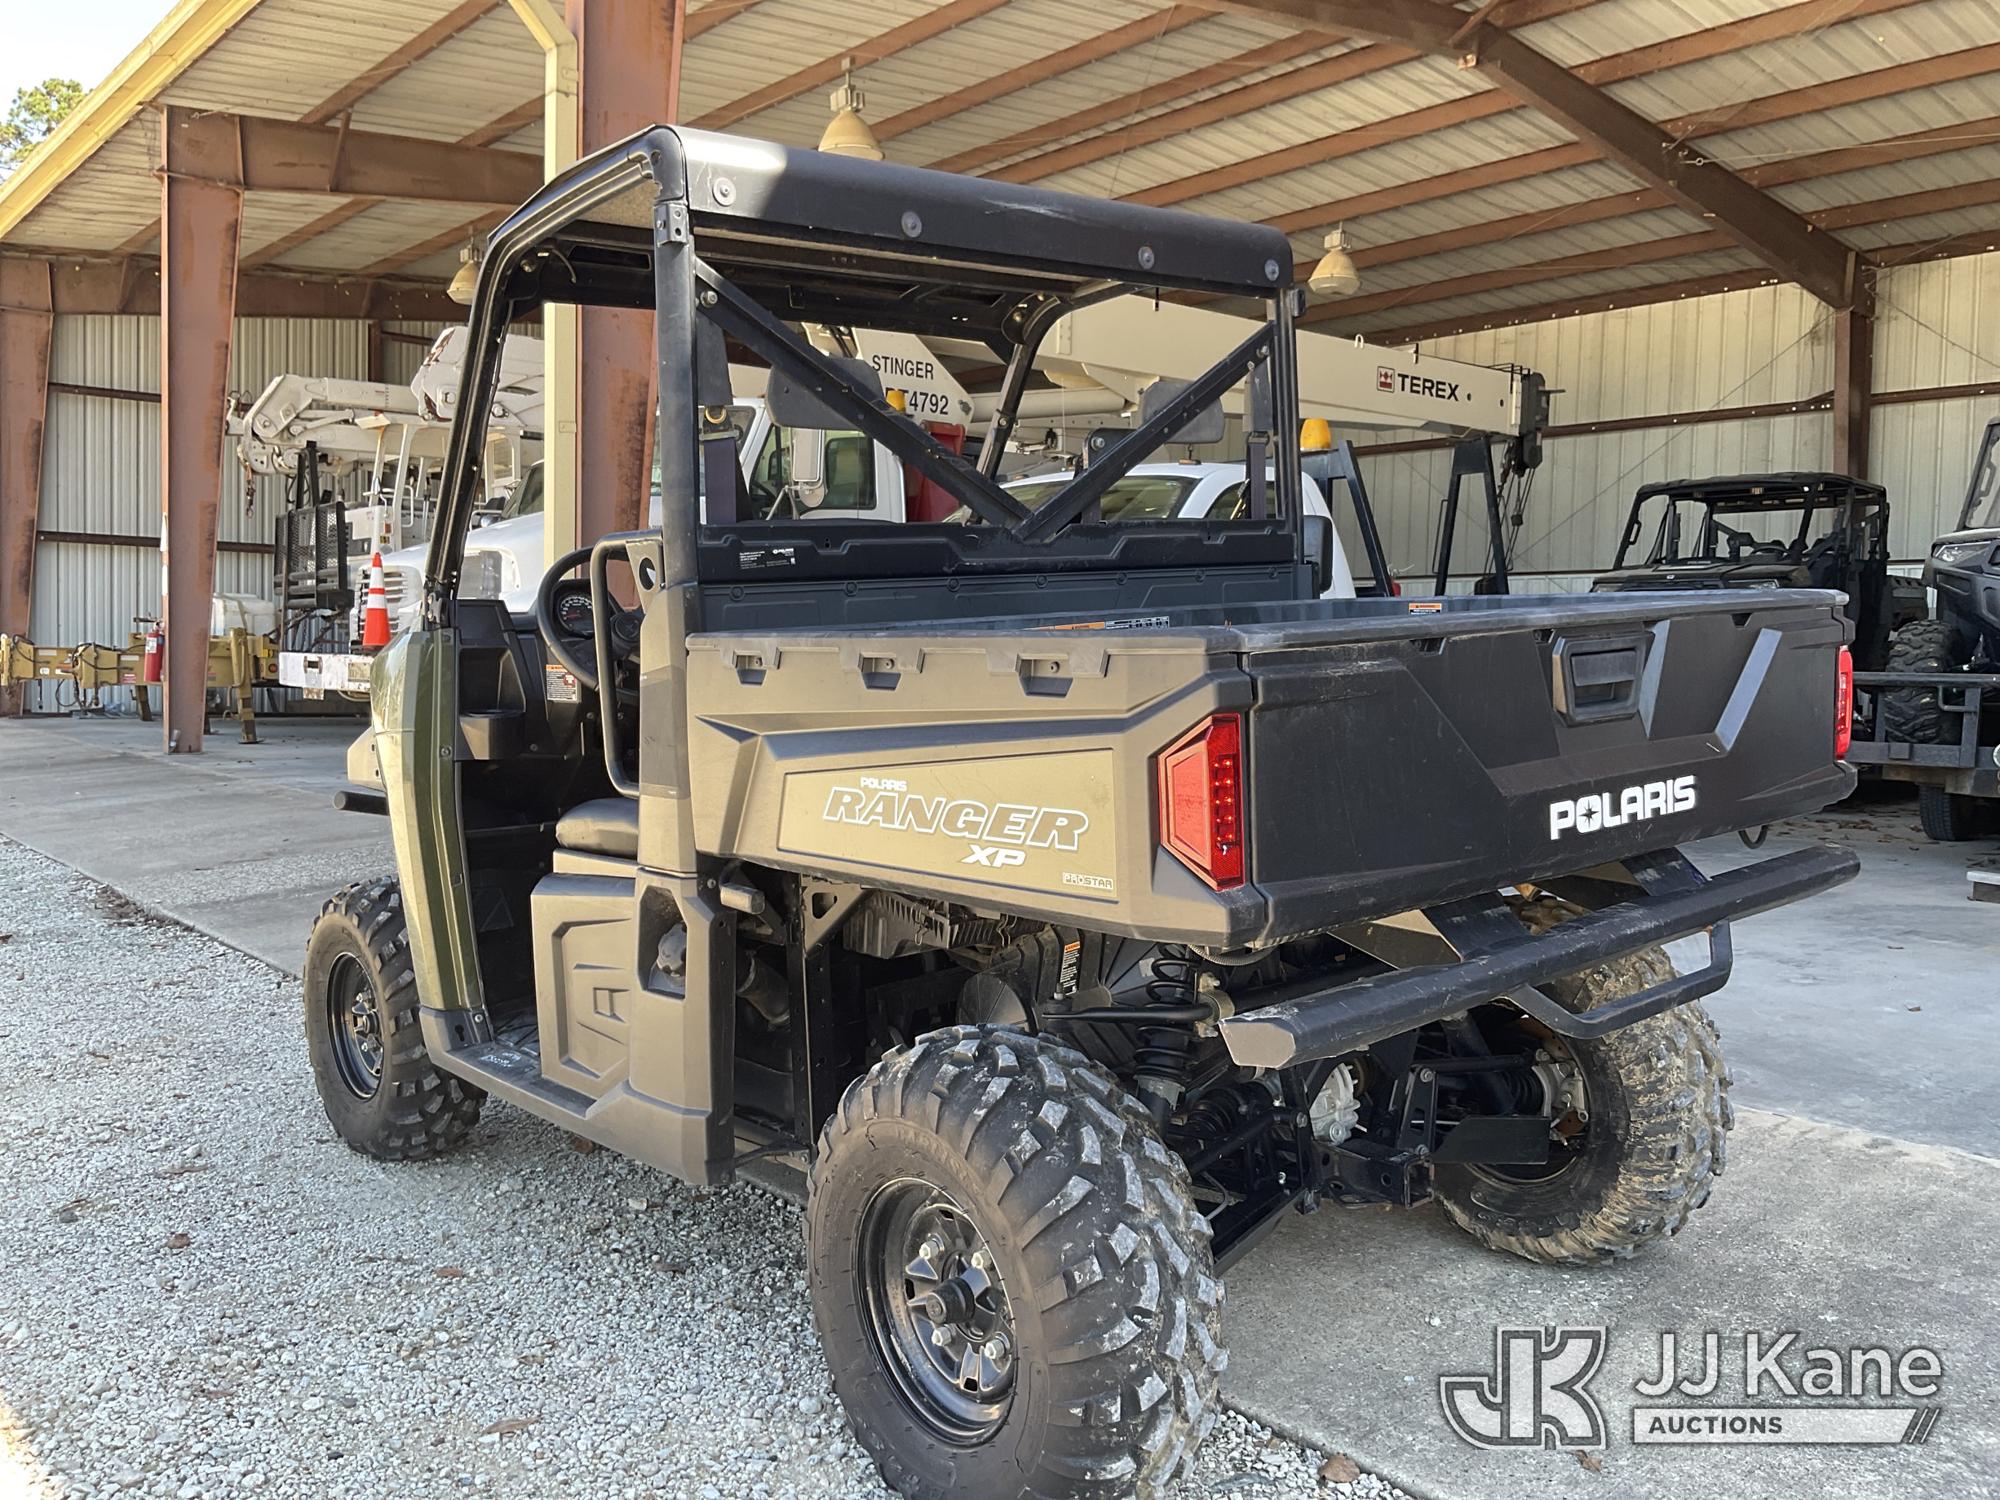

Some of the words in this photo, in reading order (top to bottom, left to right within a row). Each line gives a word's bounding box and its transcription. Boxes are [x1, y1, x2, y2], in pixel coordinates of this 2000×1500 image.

[872, 354, 934, 380] STINGER
[885, 386, 949, 415] 4792
[1397, 372, 1460, 402] TEREX
[860, 776, 907, 792] POLARIS
[823, 786, 1089, 851] RANGER
[1550, 774, 1697, 841] POLARIS
[960, 844, 1027, 868] XP
